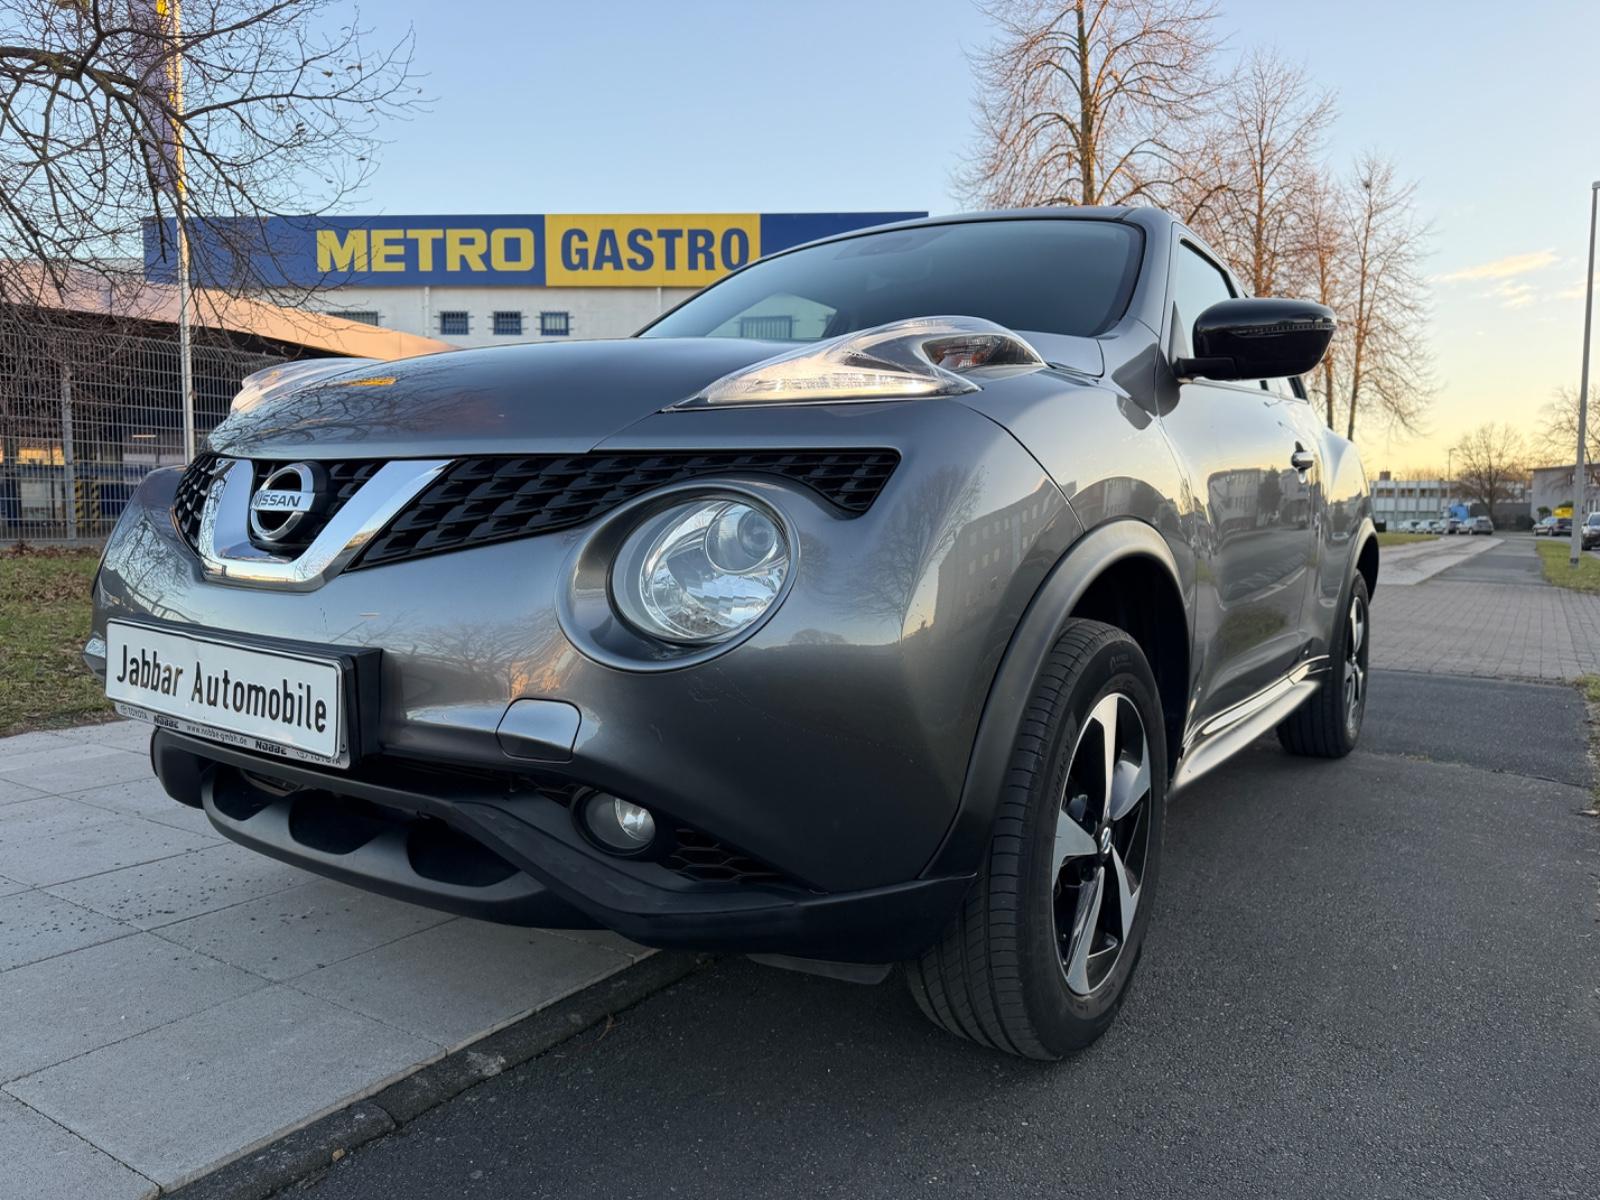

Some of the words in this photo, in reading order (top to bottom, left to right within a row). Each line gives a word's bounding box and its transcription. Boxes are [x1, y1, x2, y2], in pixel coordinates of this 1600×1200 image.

[316, 228, 535, 272] METRO
[560, 227, 750, 271] GASTRO
[116, 644, 184, 696] Jabbar
[191, 661, 327, 732] Automobile
